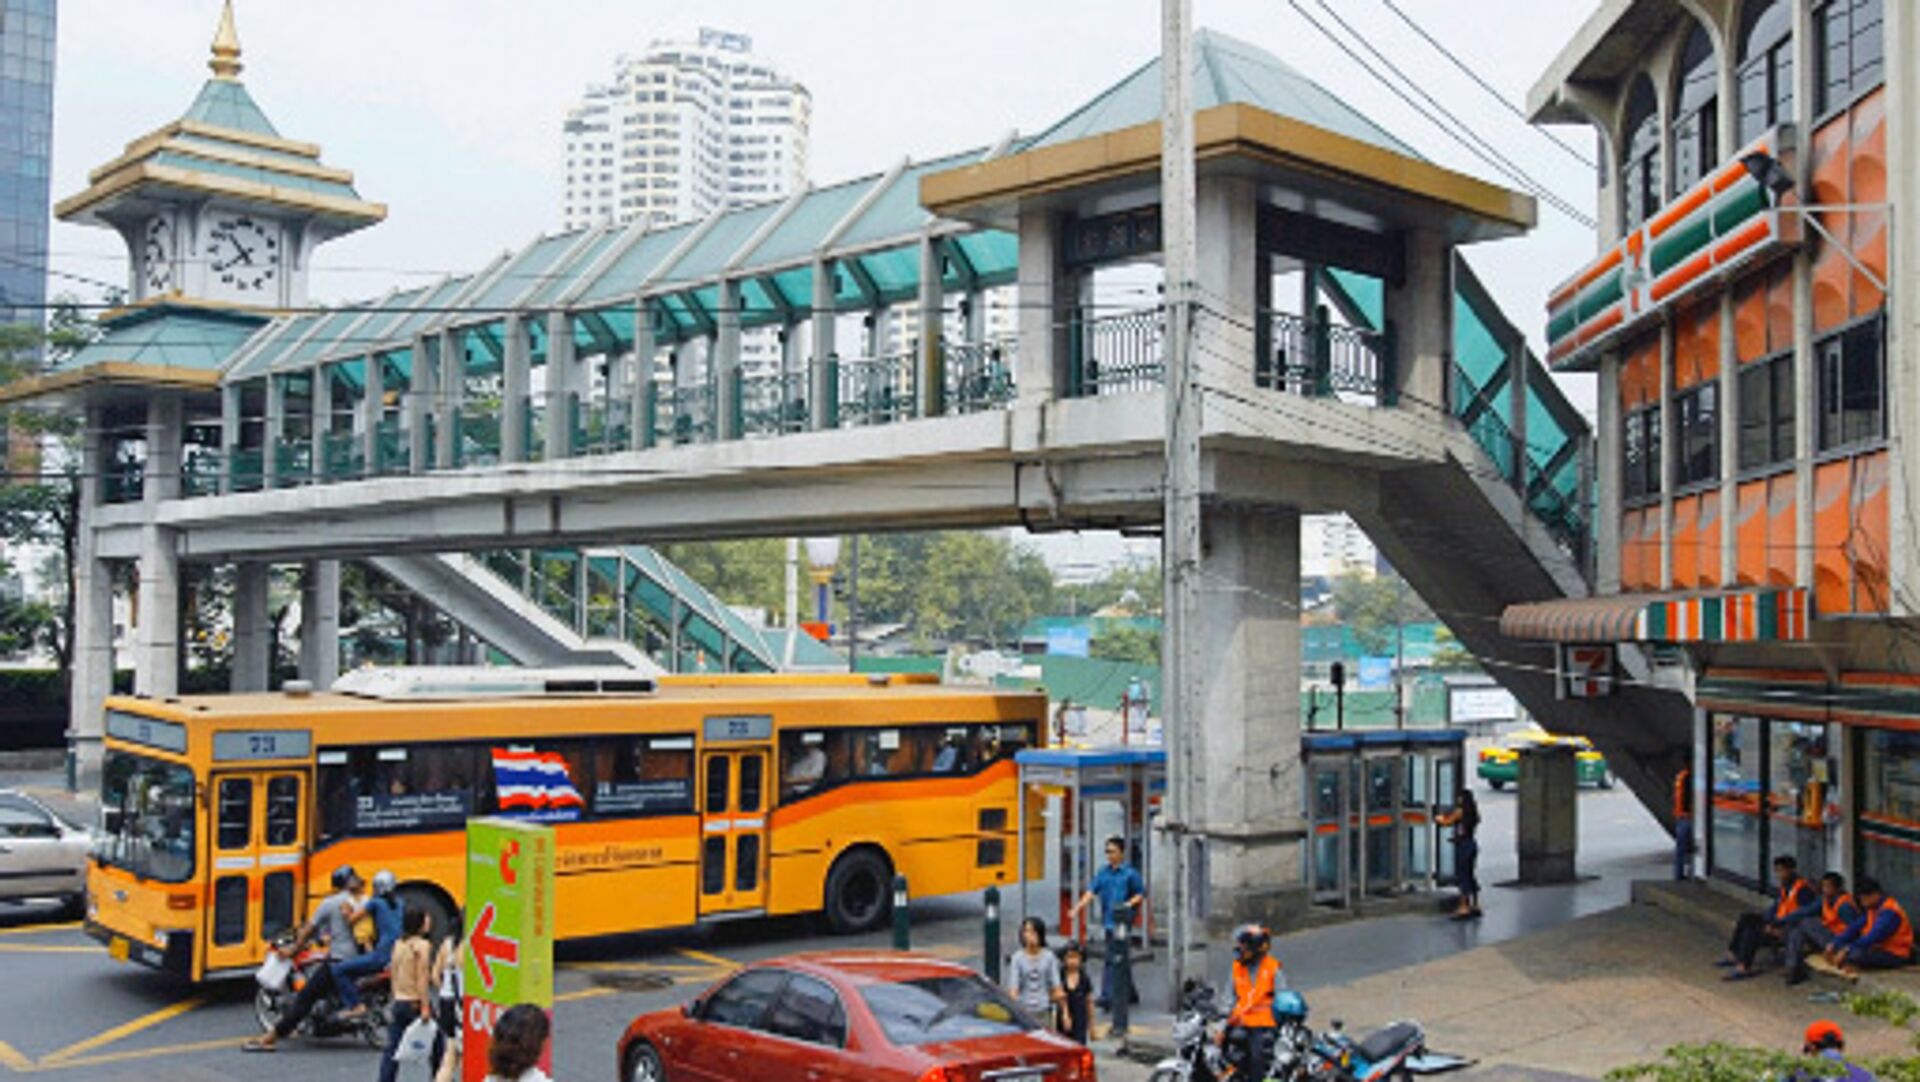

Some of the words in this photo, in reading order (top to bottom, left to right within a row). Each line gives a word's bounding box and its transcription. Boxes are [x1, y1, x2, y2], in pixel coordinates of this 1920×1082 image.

[1573, 650, 1605, 697] 7
[248, 735, 275, 753] 73
[470, 998, 506, 1037] OU
